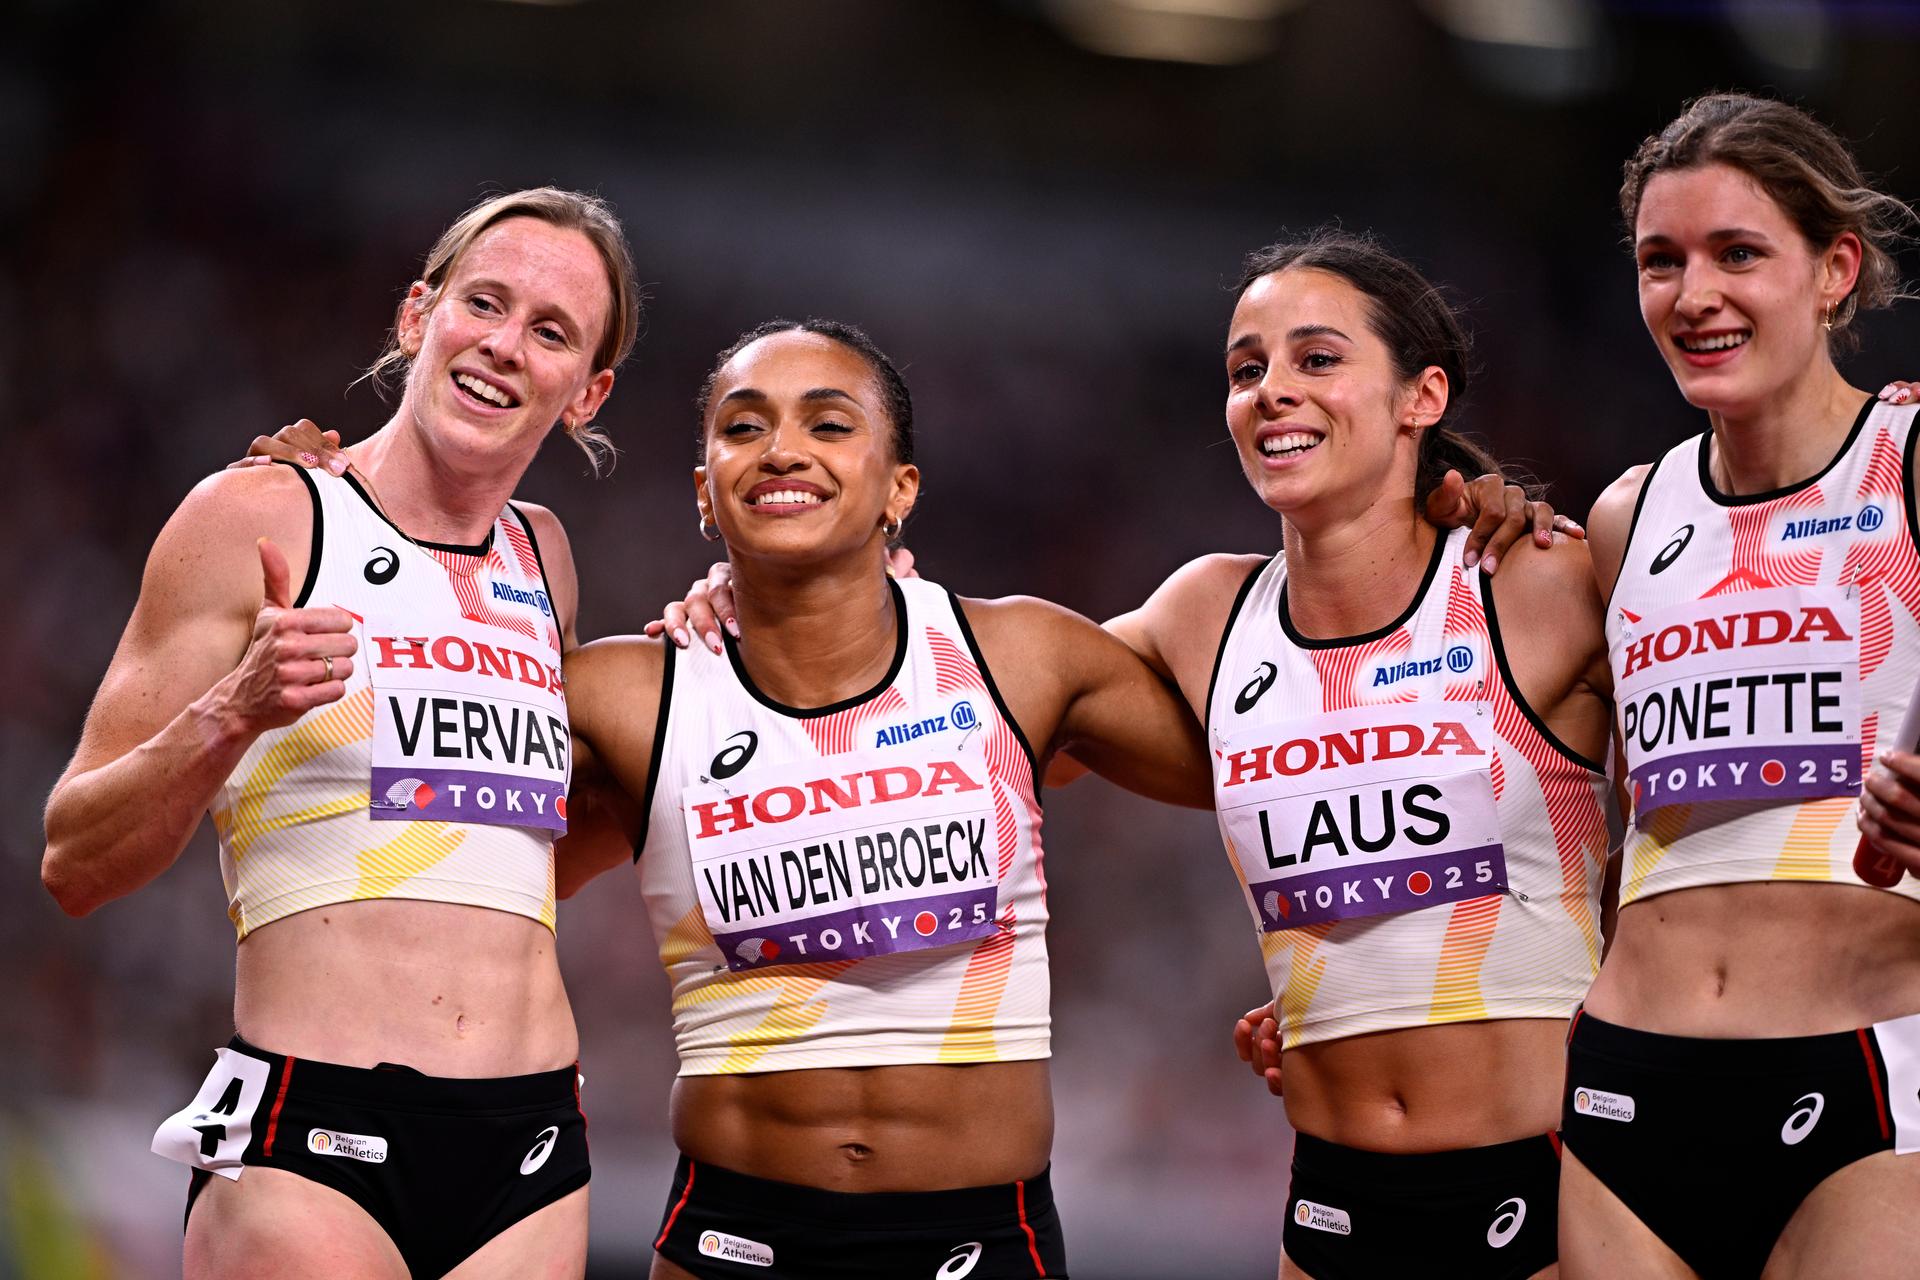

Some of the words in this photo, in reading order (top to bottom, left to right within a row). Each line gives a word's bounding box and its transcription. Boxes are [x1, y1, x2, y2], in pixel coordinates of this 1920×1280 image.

[1781, 516, 1852, 541] Allianz
[491, 581, 537, 607] Allianz
[1622, 607, 1853, 679] HONDA
[1372, 656, 1442, 687] Allianz
[1624, 671, 1843, 752] PONETTE
[875, 715, 947, 748] Allianz
[1223, 722, 1486, 787] HONDA
[1799, 759, 1848, 783] 25
[691, 761, 983, 839] HONDA
[1258, 784, 1450, 870] LAUS
[704, 855, 780, 923] VAN
[780, 840, 853, 909] DEN
[854, 818, 989, 894] BROECK
[1444, 860, 1493, 889] 25
[947, 903, 987, 930] 25
[1591, 1102, 1632, 1119] Athletics
[1592, 1093, 1617, 1103] Belgian
[333, 1144, 384, 1160] Athletics
[335, 1135, 367, 1145] Belgian
[1311, 1216, 1349, 1232] Athletics
[1312, 1206, 1334, 1217] Belgian
[721, 1247, 771, 1264] Athletics
[723, 1237, 752, 1250] Belgian
